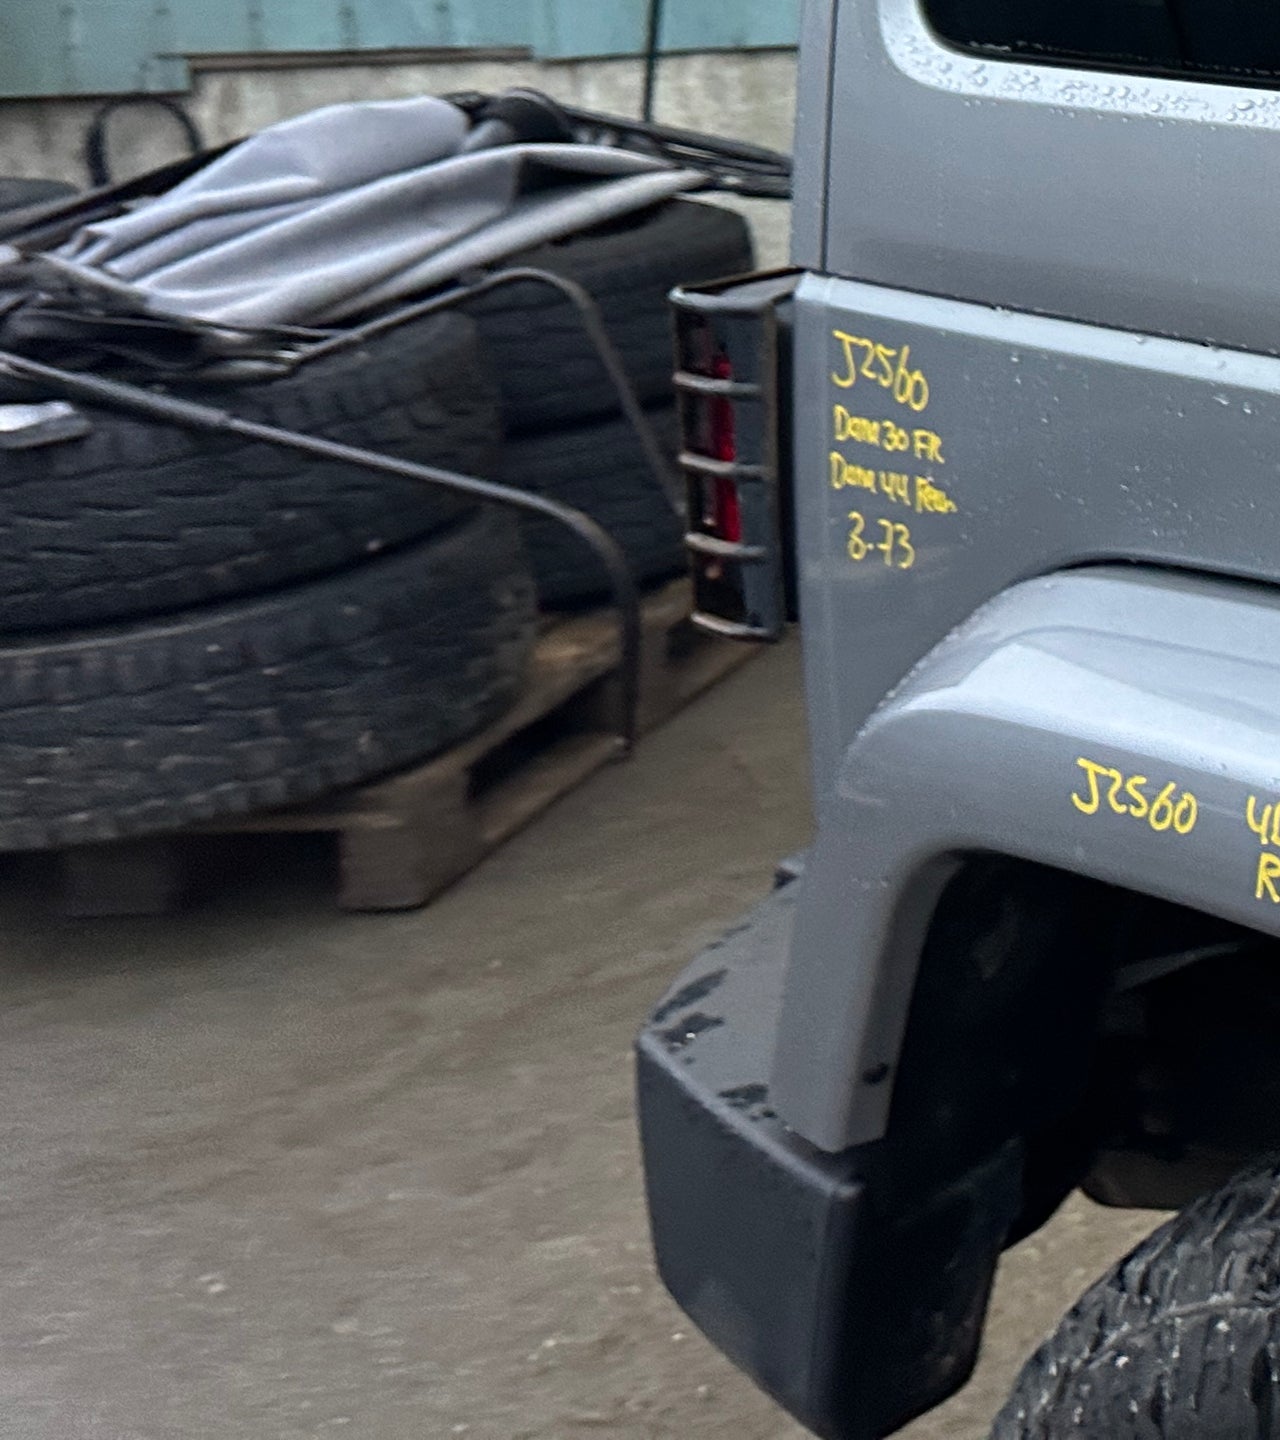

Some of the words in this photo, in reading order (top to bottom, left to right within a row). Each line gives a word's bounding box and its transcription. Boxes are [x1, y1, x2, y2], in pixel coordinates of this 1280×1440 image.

[831, 329, 929, 411] J2560
[881, 420, 910, 452] 30
[912, 428, 945, 464] FR
[878, 471, 911, 506] 44
[1071, 757, 1198, 834] J2560
